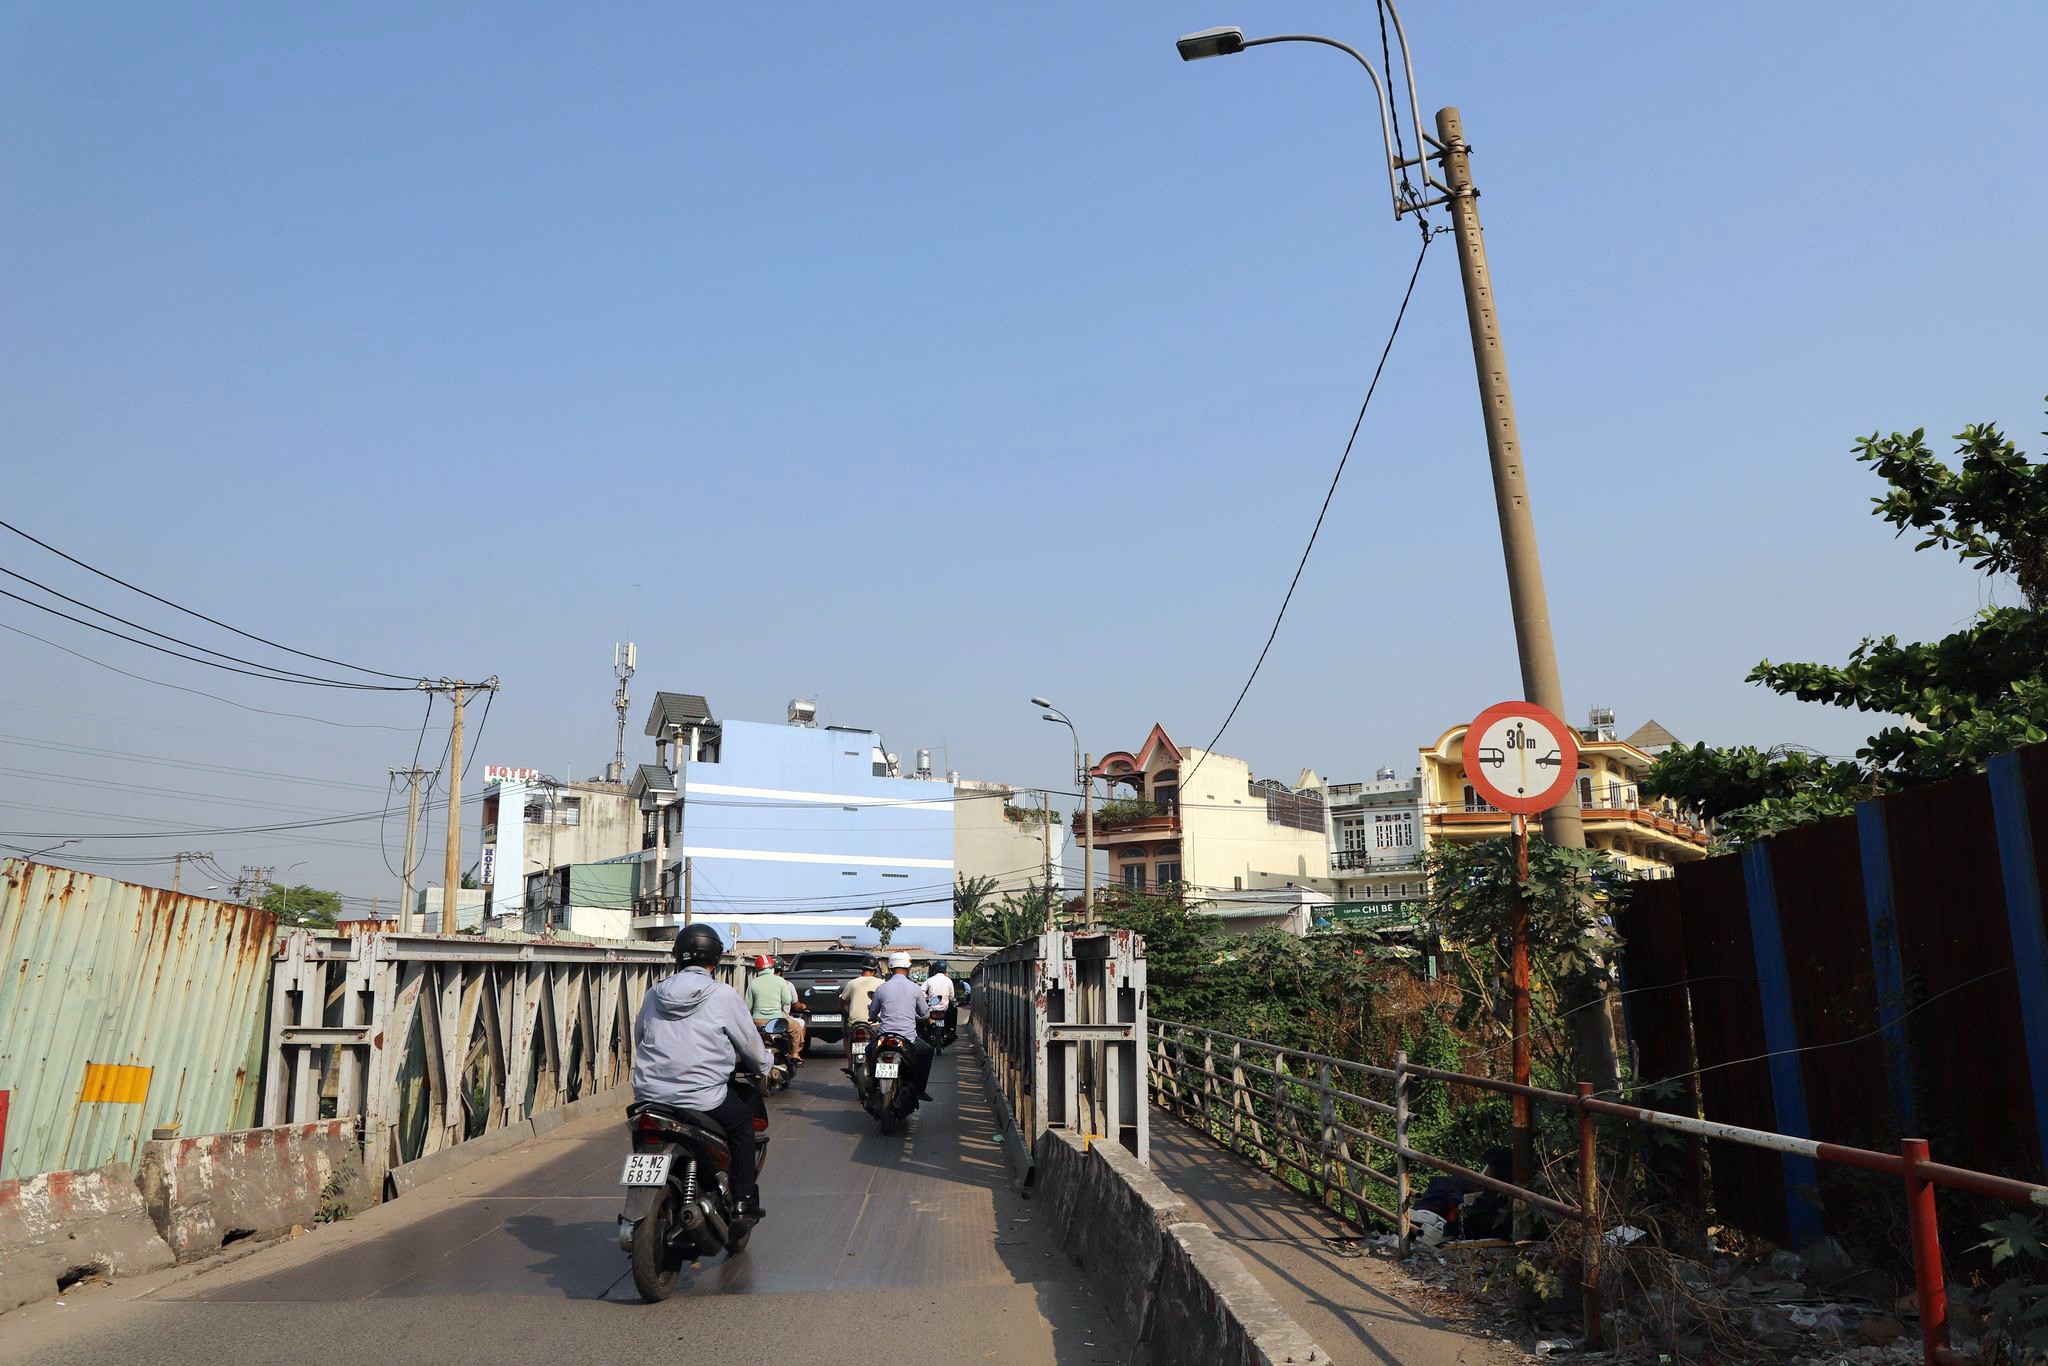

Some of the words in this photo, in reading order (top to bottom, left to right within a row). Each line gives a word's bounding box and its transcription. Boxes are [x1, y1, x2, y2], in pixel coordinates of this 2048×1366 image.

[1506, 729, 1536, 749] 30m
[489, 765, 535, 779] HOTEL
[484, 848, 493, 883] HOTEL
[1362, 905, 1379, 914] CHỊ
[630, 1156, 664, 1169] 54-M2
[627, 1170, 661, 1183] 6837
